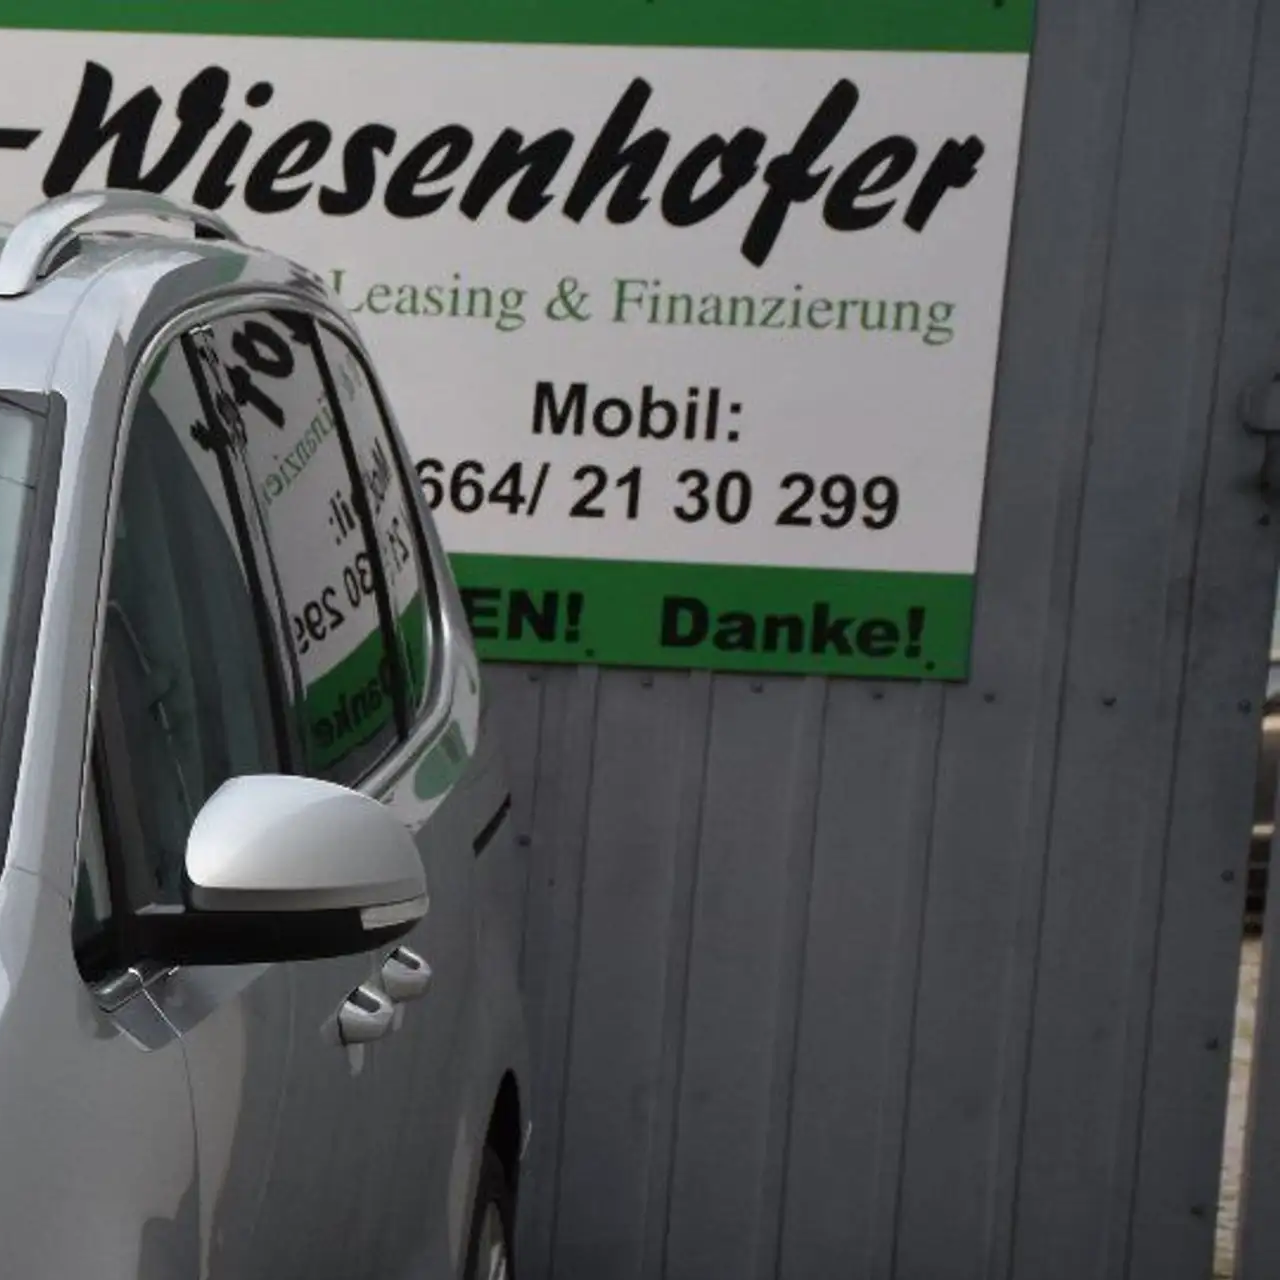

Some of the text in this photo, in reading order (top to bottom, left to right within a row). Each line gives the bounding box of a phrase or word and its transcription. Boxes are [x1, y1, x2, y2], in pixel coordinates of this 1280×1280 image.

[546, 276, 591, 322] &
[612, 277, 957, 346] Finanzierung
[532, 381, 743, 443] Mobil:
[569, 464, 643, 520] 21
[673, 468, 754, 526] 30
[775, 471, 902, 531] 299
[660, 595, 926, 658] Danke!
